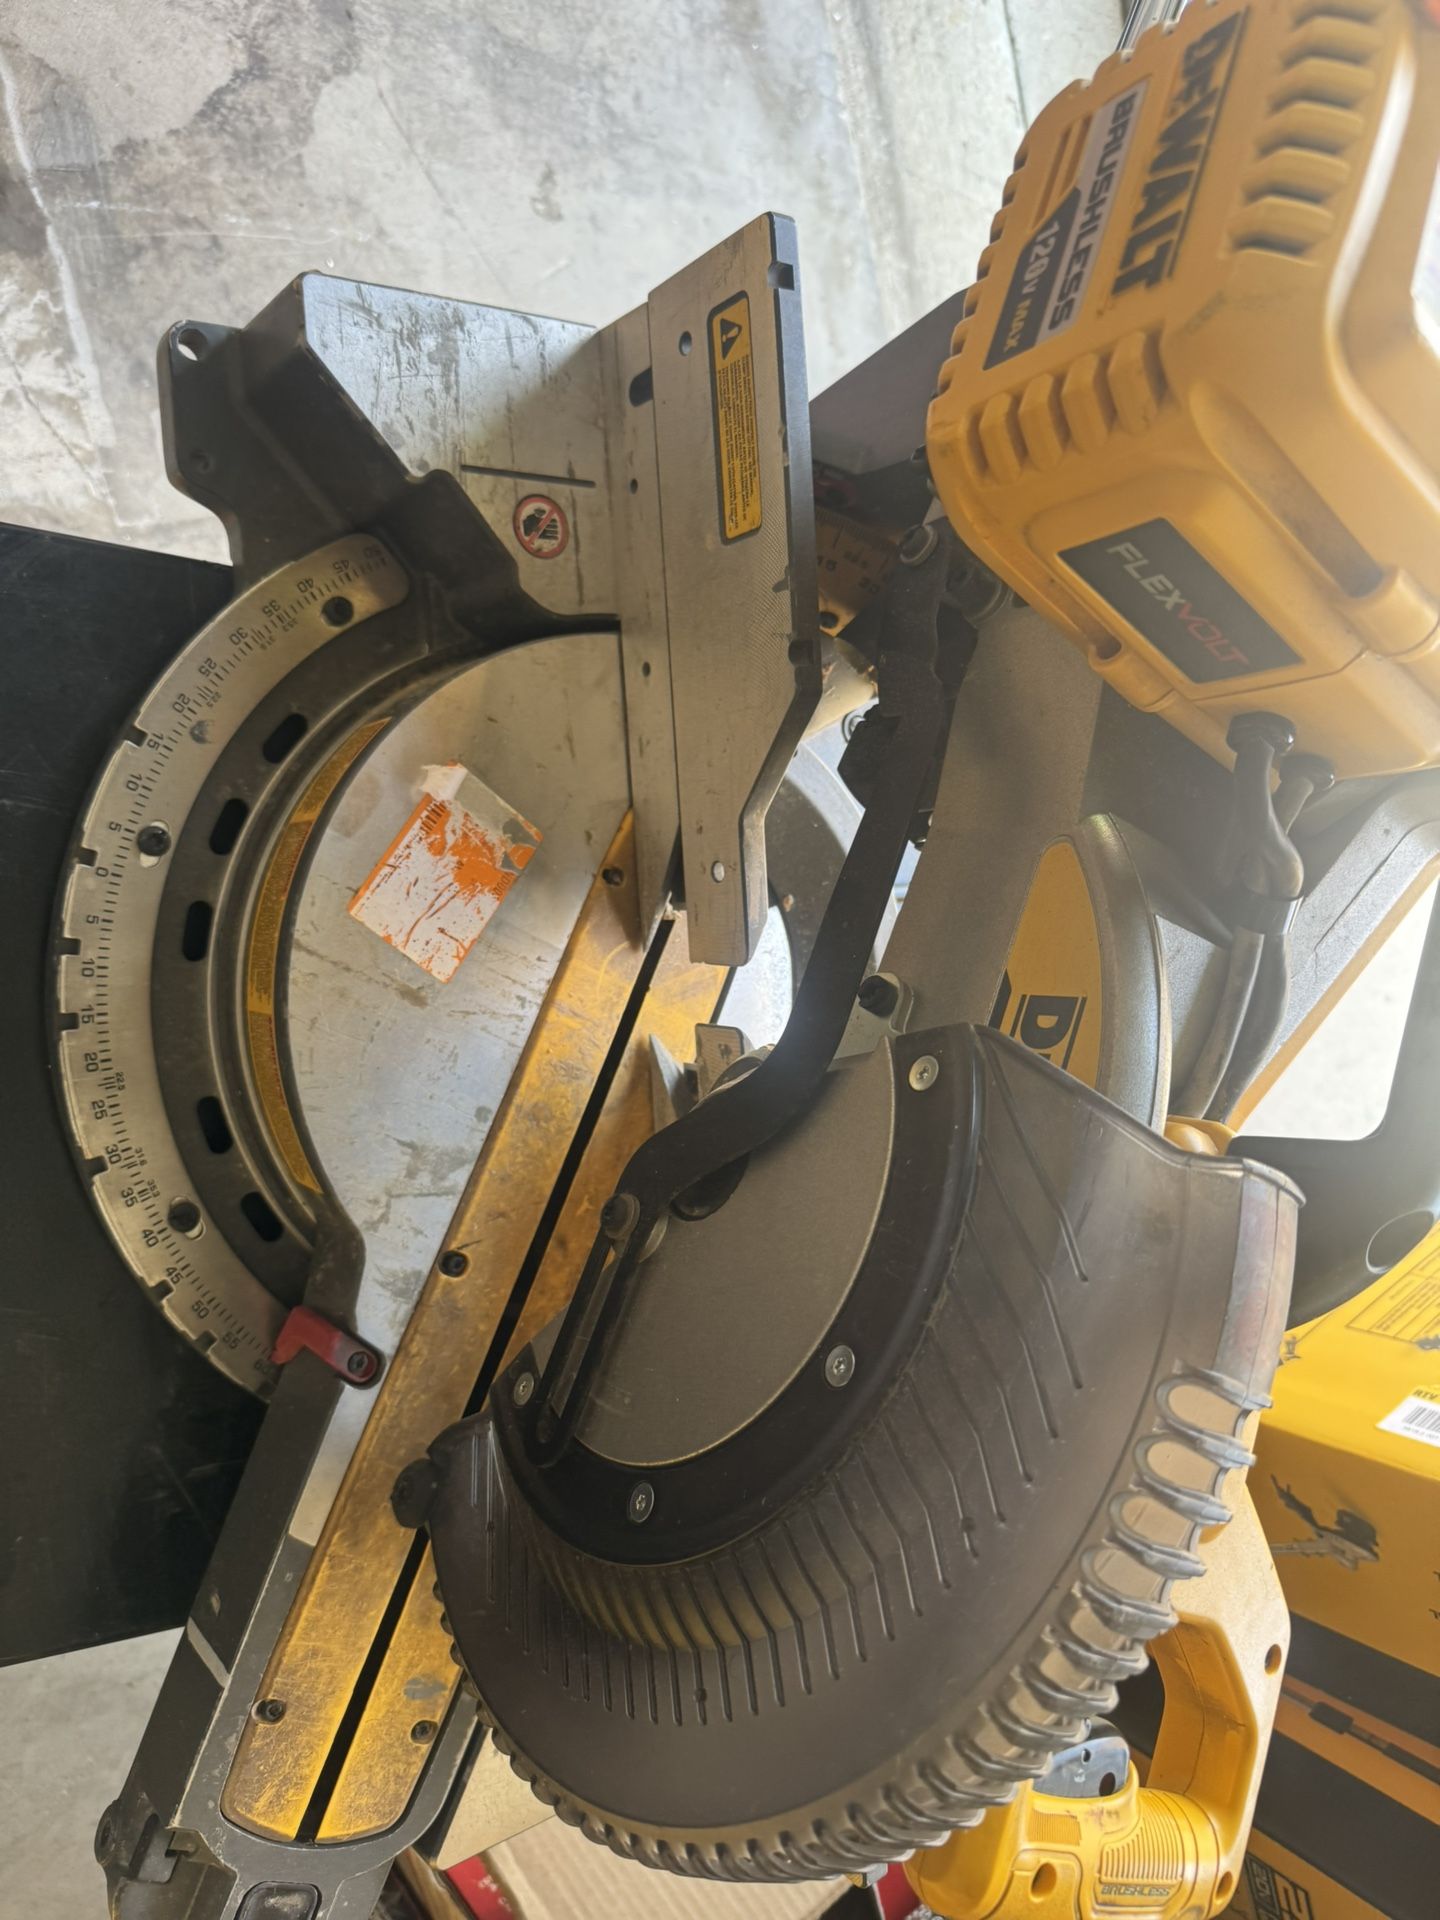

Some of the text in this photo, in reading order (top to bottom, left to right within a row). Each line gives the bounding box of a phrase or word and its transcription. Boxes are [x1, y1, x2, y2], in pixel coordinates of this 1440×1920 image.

[1048, 91, 1139, 331] BRUSHLESS
[1004, 299, 1033, 354] MAX
[332, 558, 352, 574] 45
[297, 576, 316, 594] 40
[262, 599, 283, 618] 35
[1106, 541, 1249, 665] FLEXVOLT
[229, 626, 250, 647] 30
[197, 657, 219, 678] 25
[171, 692, 192, 714] 20
[146, 732, 166, 752] 15
[125, 773, 144, 792] 10
[108, 821, 123, 833] 5
[95, 866, 110, 878] 0
[85, 913, 100, 925] 5
[81, 958, 96, 978] 10
[80, 1004, 96, 1025] 15
[83, 1051, 100, 1073] 20
[90, 1099, 109, 1121] 25
[104, 1143, 122, 1165] 30
[119, 1187, 140, 1208] 35
[141, 1228, 161, 1249] 40
[165, 1266, 186, 1287] 45
[190, 1300, 211, 1320] 50
[221, 1331, 243, 1351] 55
